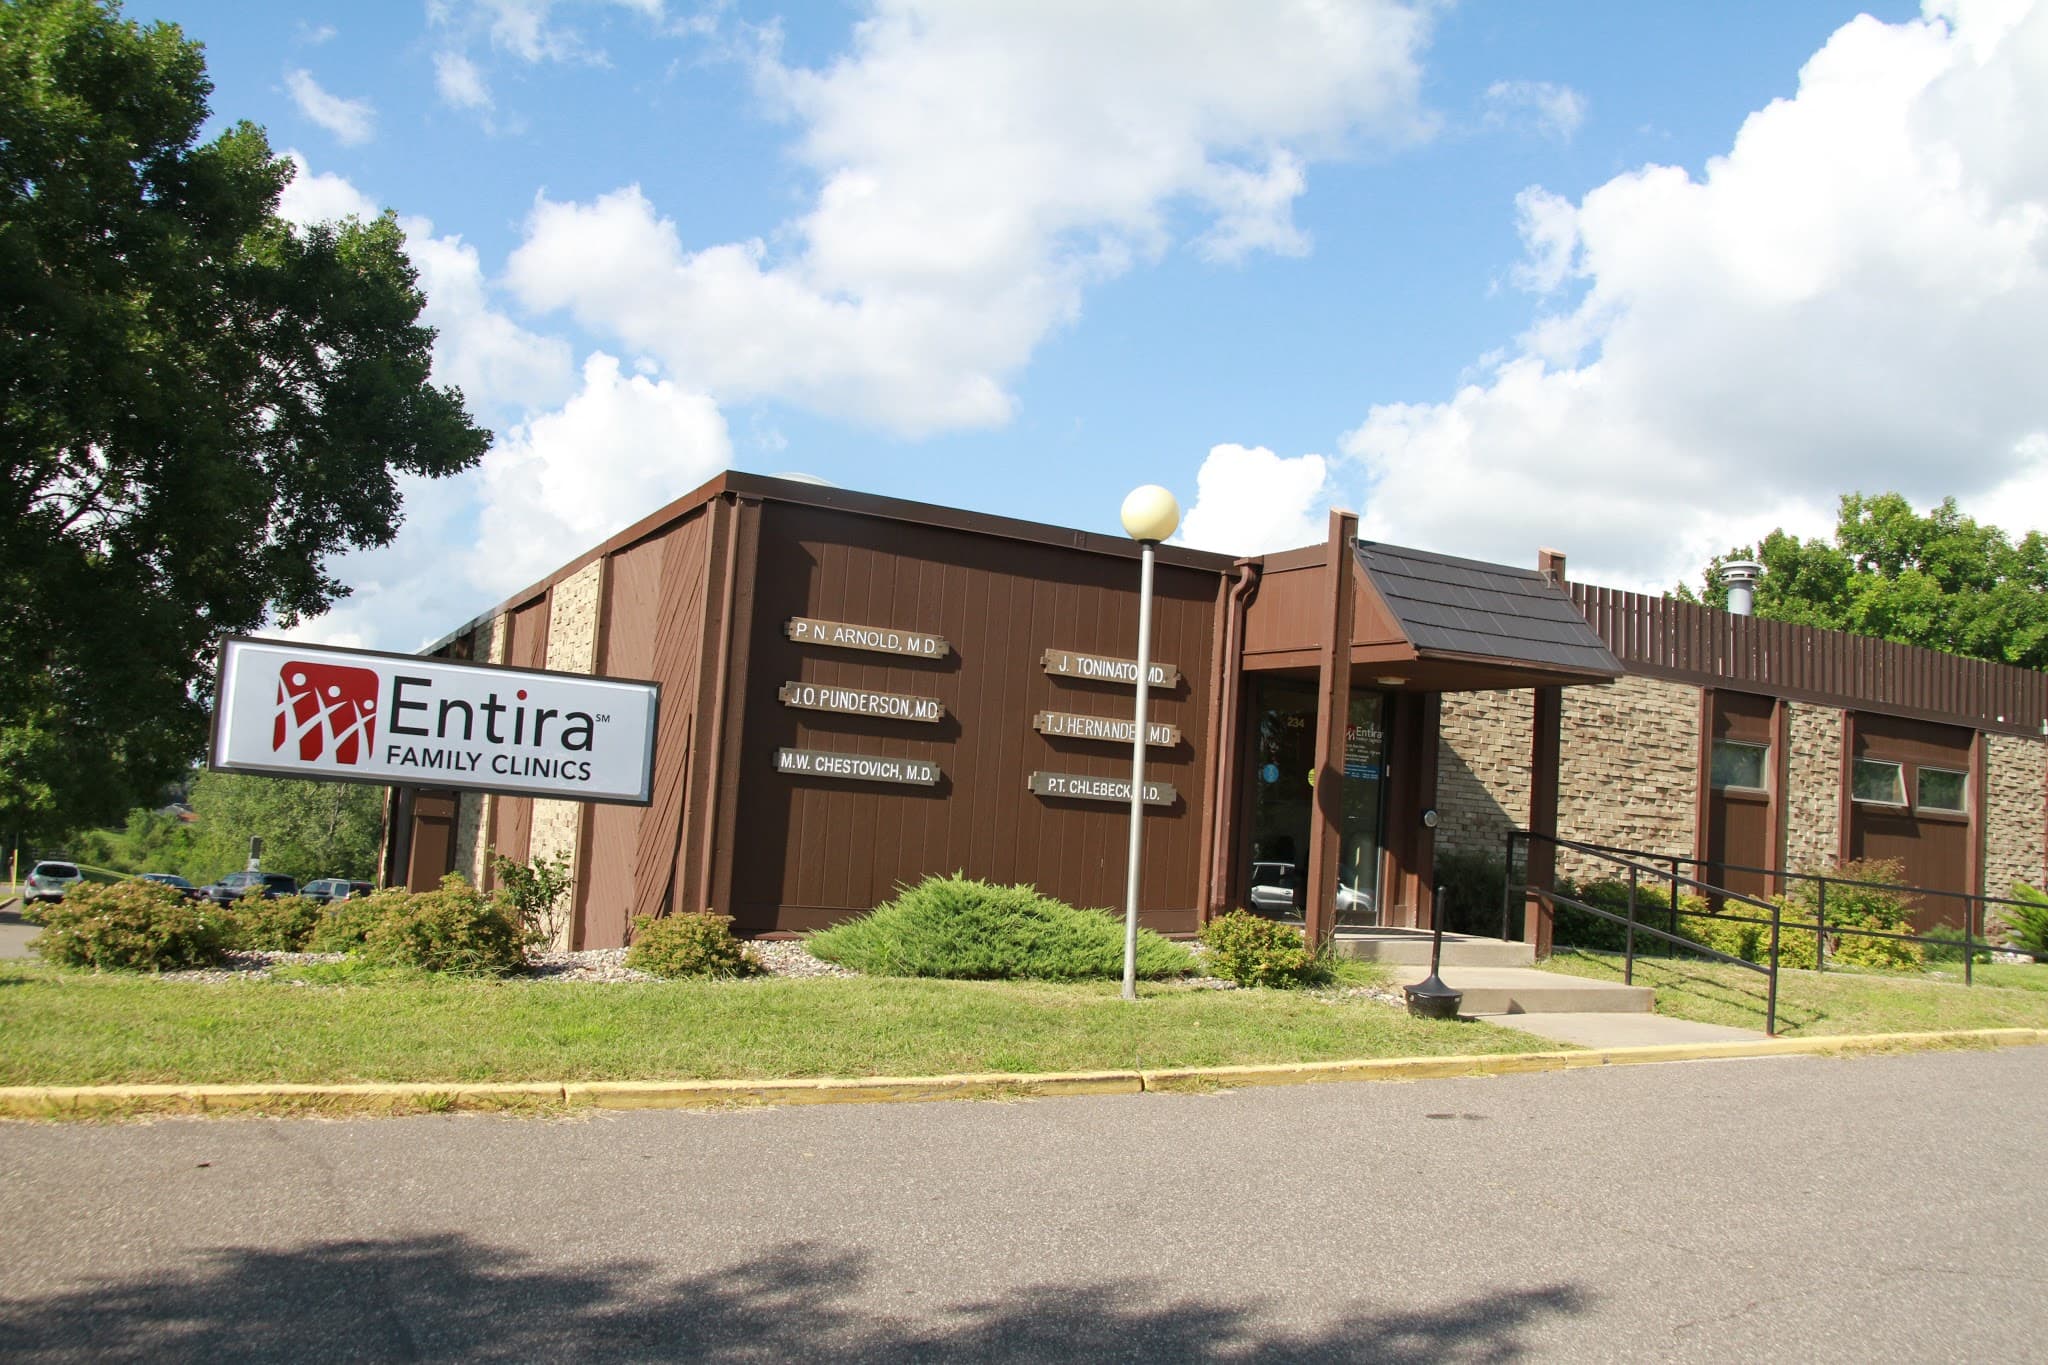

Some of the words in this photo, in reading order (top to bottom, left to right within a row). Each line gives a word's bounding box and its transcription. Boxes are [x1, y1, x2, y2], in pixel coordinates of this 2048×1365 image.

[834, 628, 902, 651] ARNOLD,
[907, 637, 937, 654] M.D.
[1059, 655, 1070, 672] J.
[389, 675, 595, 751] Entira
[1288, 716, 1304, 728] 234
[1356, 726, 1382, 740] Entira
[386, 744, 482, 772] FAMILY
[492, 754, 591, 781] CLINICS
[780, 752, 811, 770] M.W.
[815, 756, 903, 781] CHESTOVICH,
[906, 765, 933, 781] M.D.
[1048, 778, 1066, 793] P.T.
[1142, 786, 1160, 801] .D.
